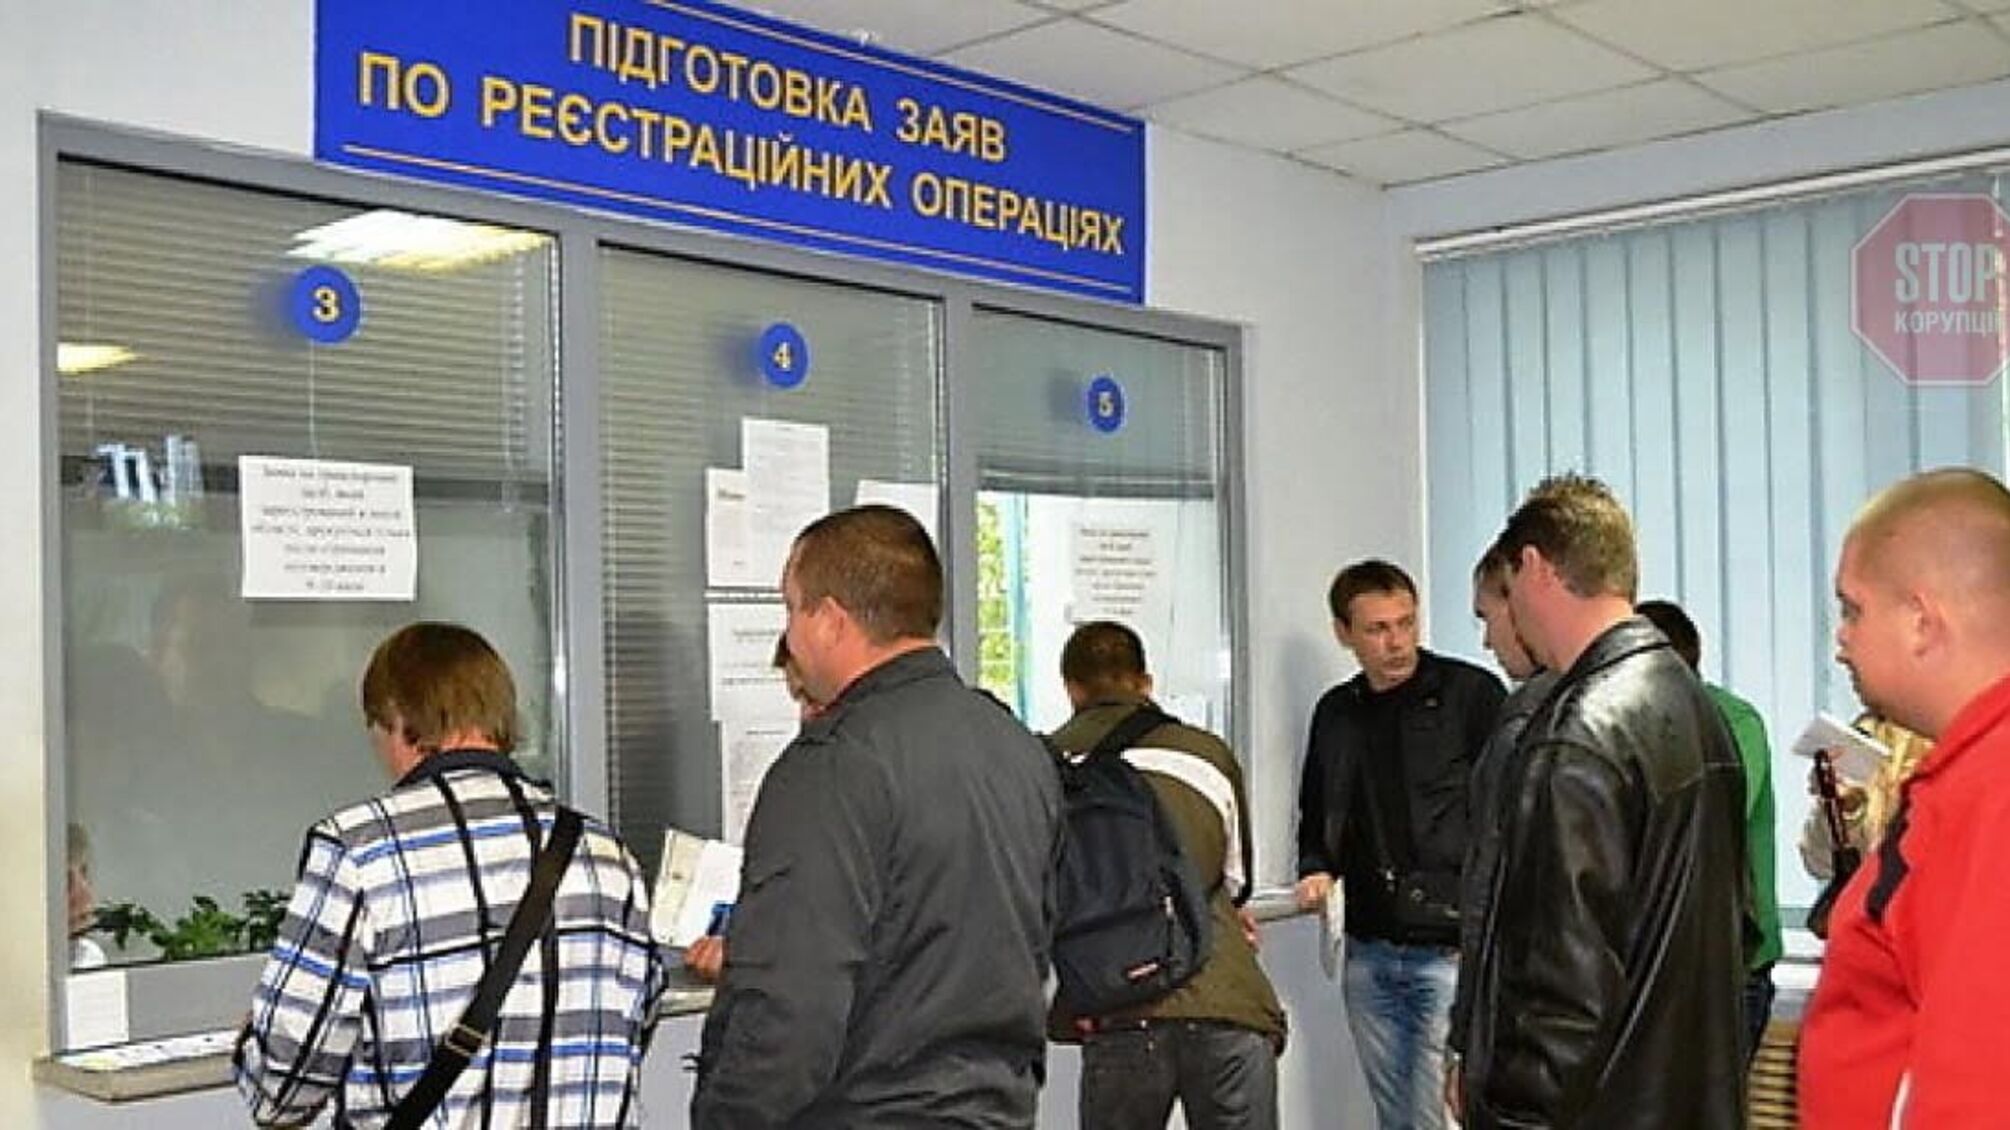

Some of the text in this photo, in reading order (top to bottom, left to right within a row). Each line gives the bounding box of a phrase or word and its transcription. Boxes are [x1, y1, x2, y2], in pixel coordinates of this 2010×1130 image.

[569, 12, 1005, 163] ПІДГОТОВКА ЗАЯВ
[359, 51, 1125, 256] ПО РЕЄСТРАЦІЙНИХ ОПЕРАЦІЯХ
[312, 285, 340, 323] 3
[773, 341, 792, 371] 4
[1098, 390, 1115, 418] 5
